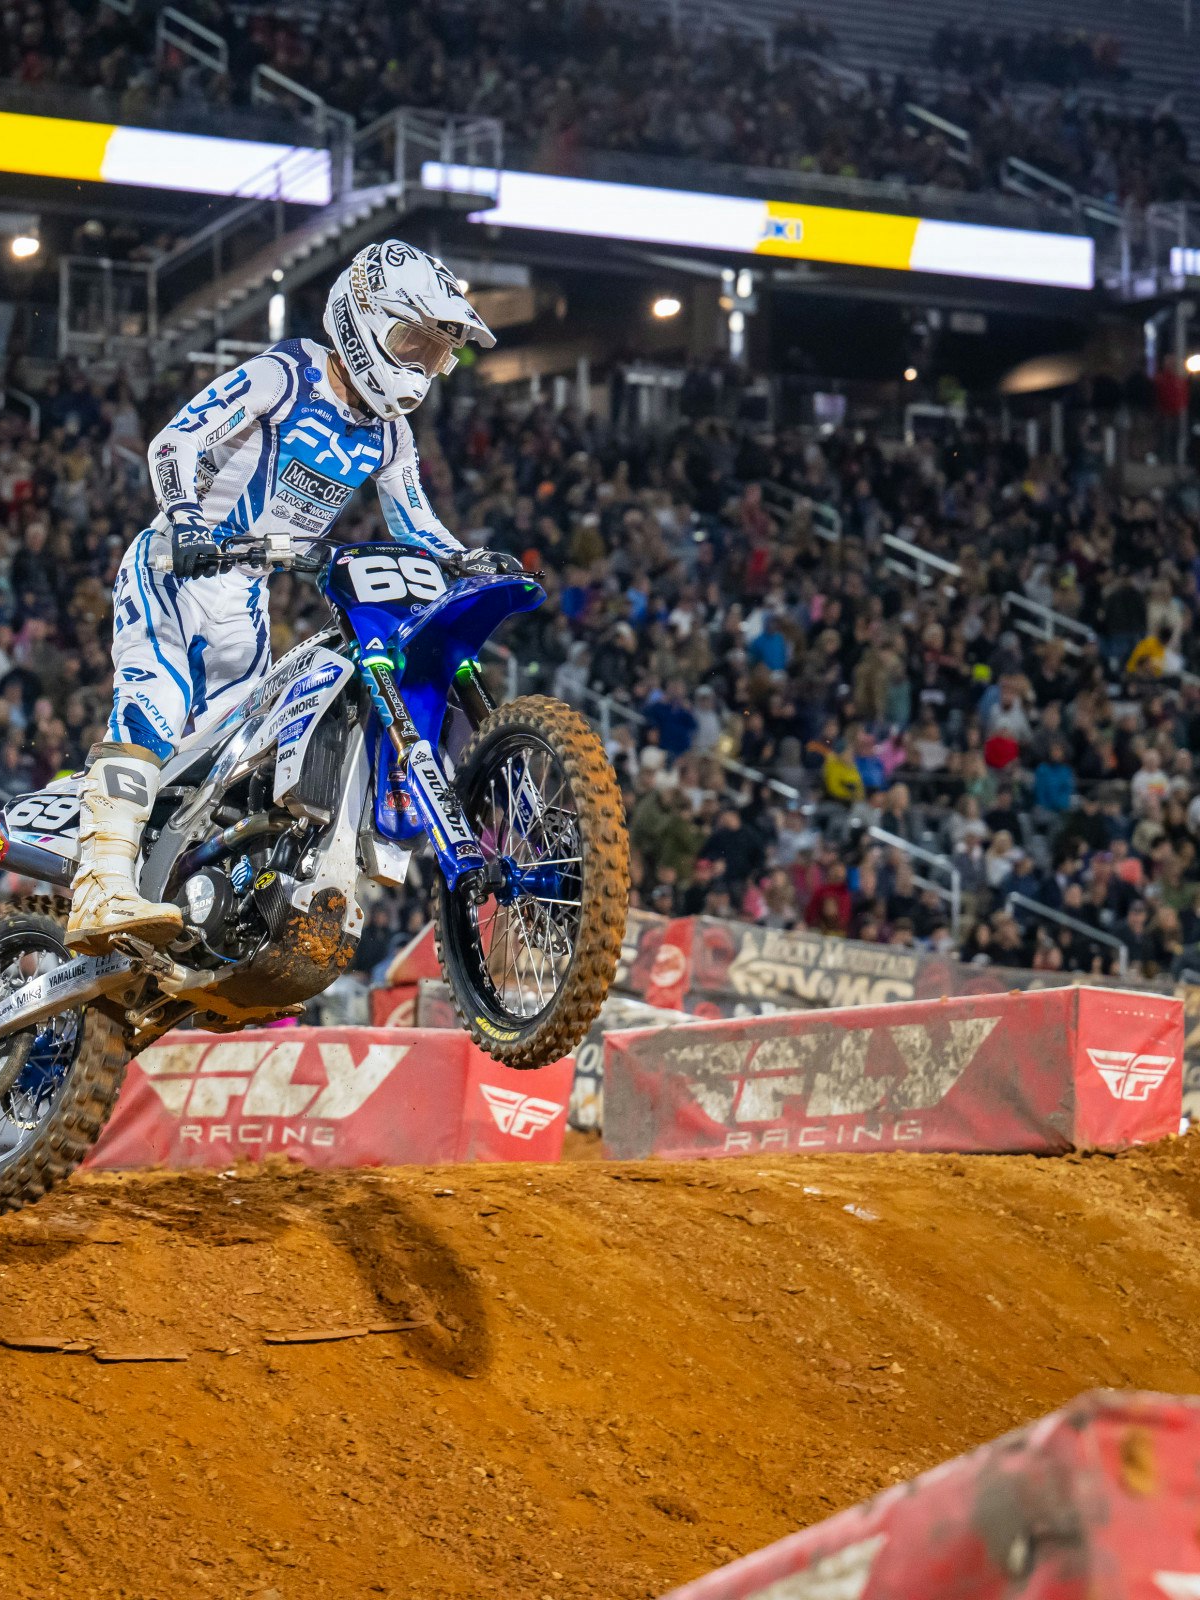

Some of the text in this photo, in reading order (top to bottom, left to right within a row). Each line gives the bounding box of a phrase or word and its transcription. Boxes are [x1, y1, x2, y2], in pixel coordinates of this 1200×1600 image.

[335, 299, 369, 372] Muc-Off
[206, 406, 247, 447] CLUBMX
[287, 466, 350, 507] Muc-Off
[348, 555, 447, 602] 69
[6, 796, 80, 830] 69
[420, 768, 467, 838] DUNOP
[48, 961, 87, 987] YAMALUBE
[134, 1041, 412, 1120] FLY
[179, 1123, 335, 1147] RACING
[724, 1119, 924, 1152] RACING
